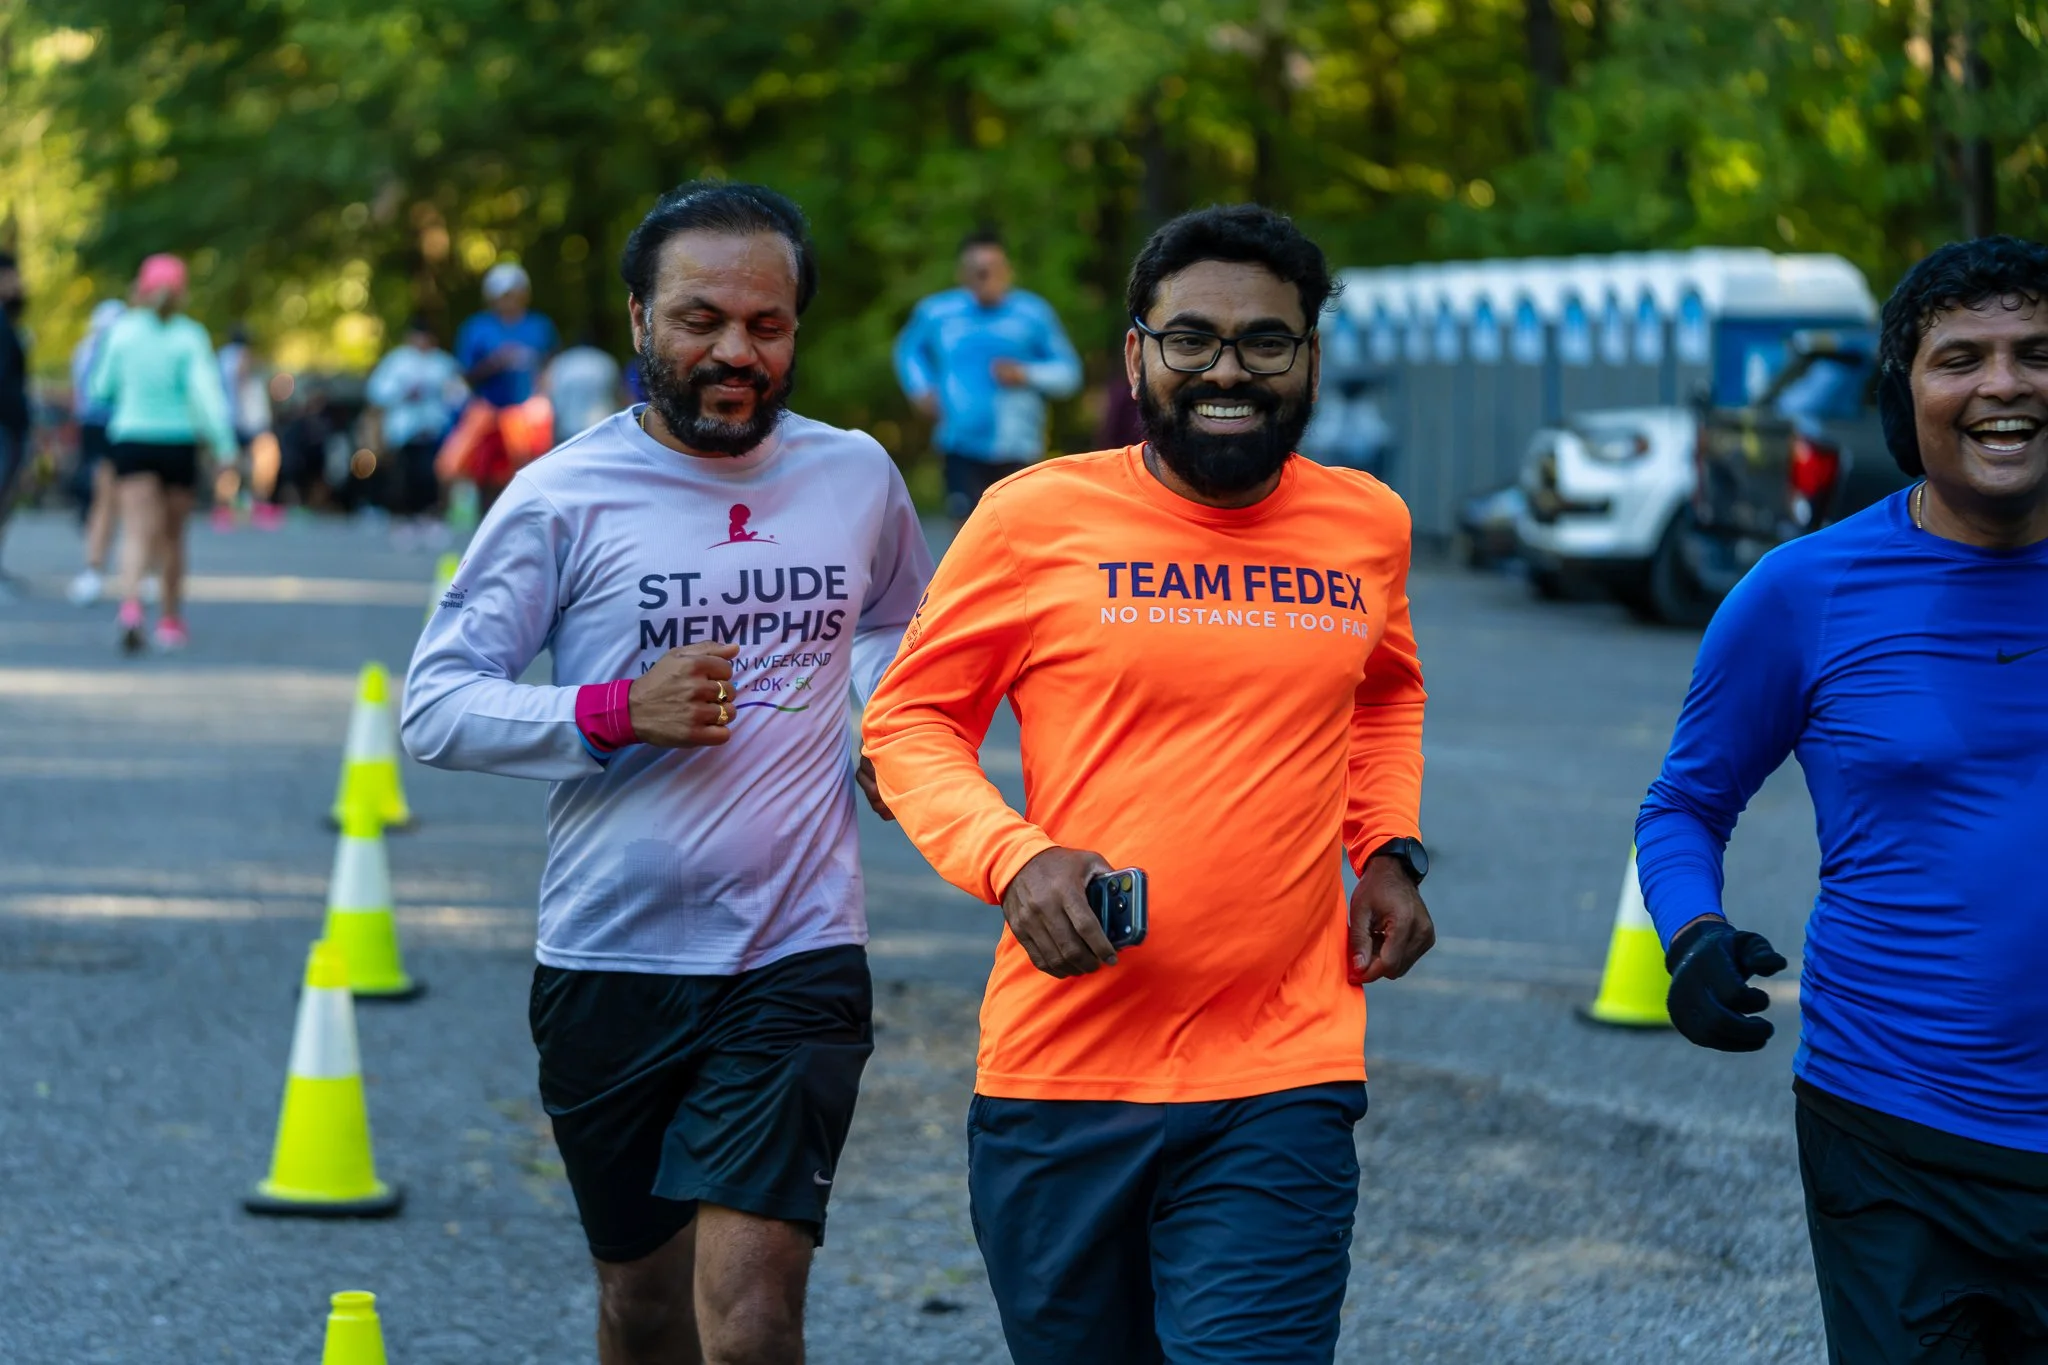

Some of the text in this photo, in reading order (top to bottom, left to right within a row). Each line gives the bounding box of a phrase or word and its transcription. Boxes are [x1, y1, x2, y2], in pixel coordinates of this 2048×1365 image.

[638, 565, 848, 609] ST. JUDE
[1098, 562, 1368, 614] TEAM FEDEX
[640, 609, 846, 651] MEMPHIS
[1100, 606, 1369, 640] NO DISTANCE TOO FAR
[754, 652, 832, 669] WEEKEND
[750, 677, 783, 692] 10K
[795, 676, 813, 691] 5K
